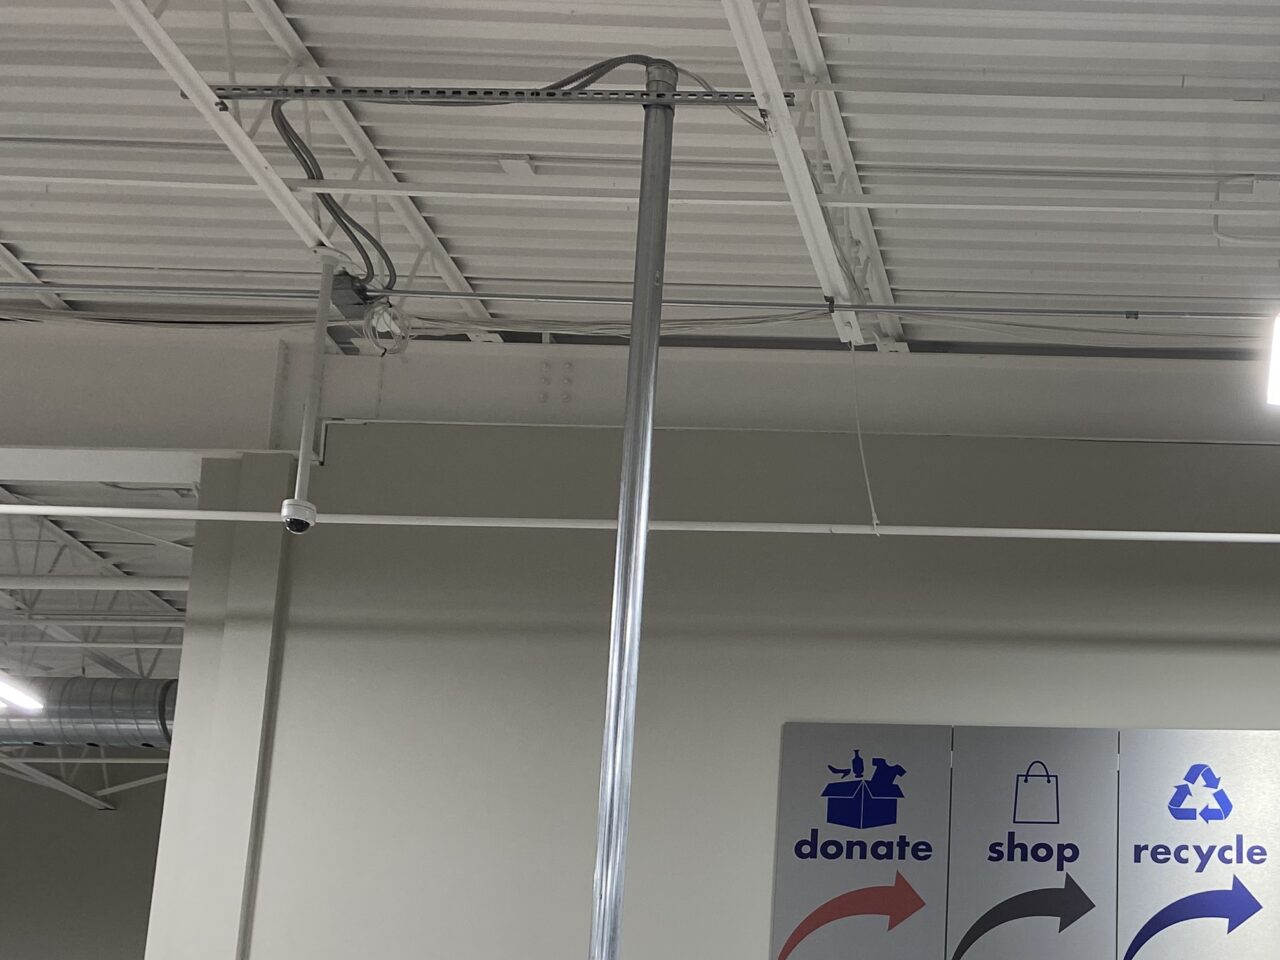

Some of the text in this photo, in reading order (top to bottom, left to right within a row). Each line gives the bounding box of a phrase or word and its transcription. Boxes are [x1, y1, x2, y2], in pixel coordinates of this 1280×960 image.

[794, 828, 933, 861] donate
[987, 831, 1080, 872] shop
[1134, 834, 1268, 872] recycle
